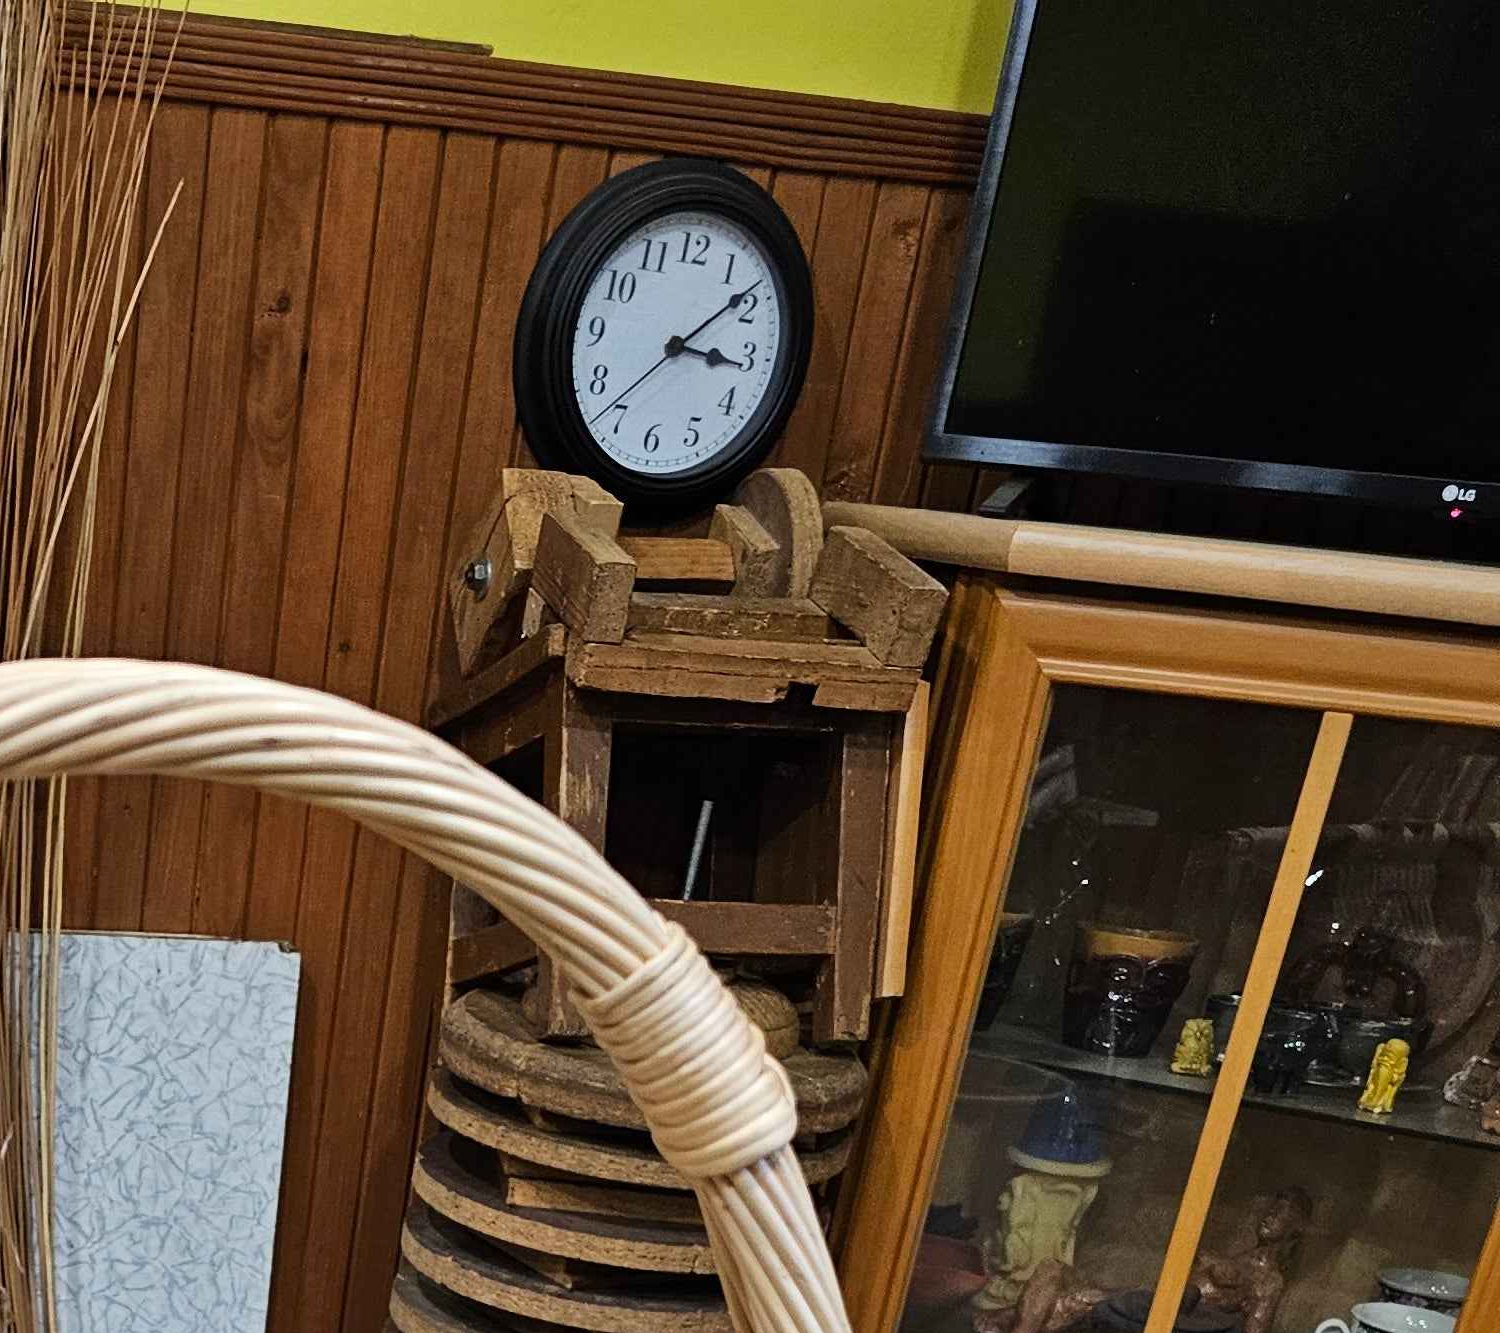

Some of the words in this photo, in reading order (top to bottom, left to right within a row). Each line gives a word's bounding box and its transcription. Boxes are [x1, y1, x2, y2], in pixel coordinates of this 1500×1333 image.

[638, 239, 669, 273] 11
[676, 232, 711, 266] 12
[721, 254, 735, 285] 1
[603, 269, 636, 303] 10
[738, 294, 758, 323] 2
[586, 316, 605, 348] 9
[738, 342, 757, 372] 3
[589, 364, 608, 395] 8
[717, 386, 736, 416] 4
[612, 404, 628, 434] 7
[683, 417, 702, 447] 5
[643, 424, 662, 453] 6
